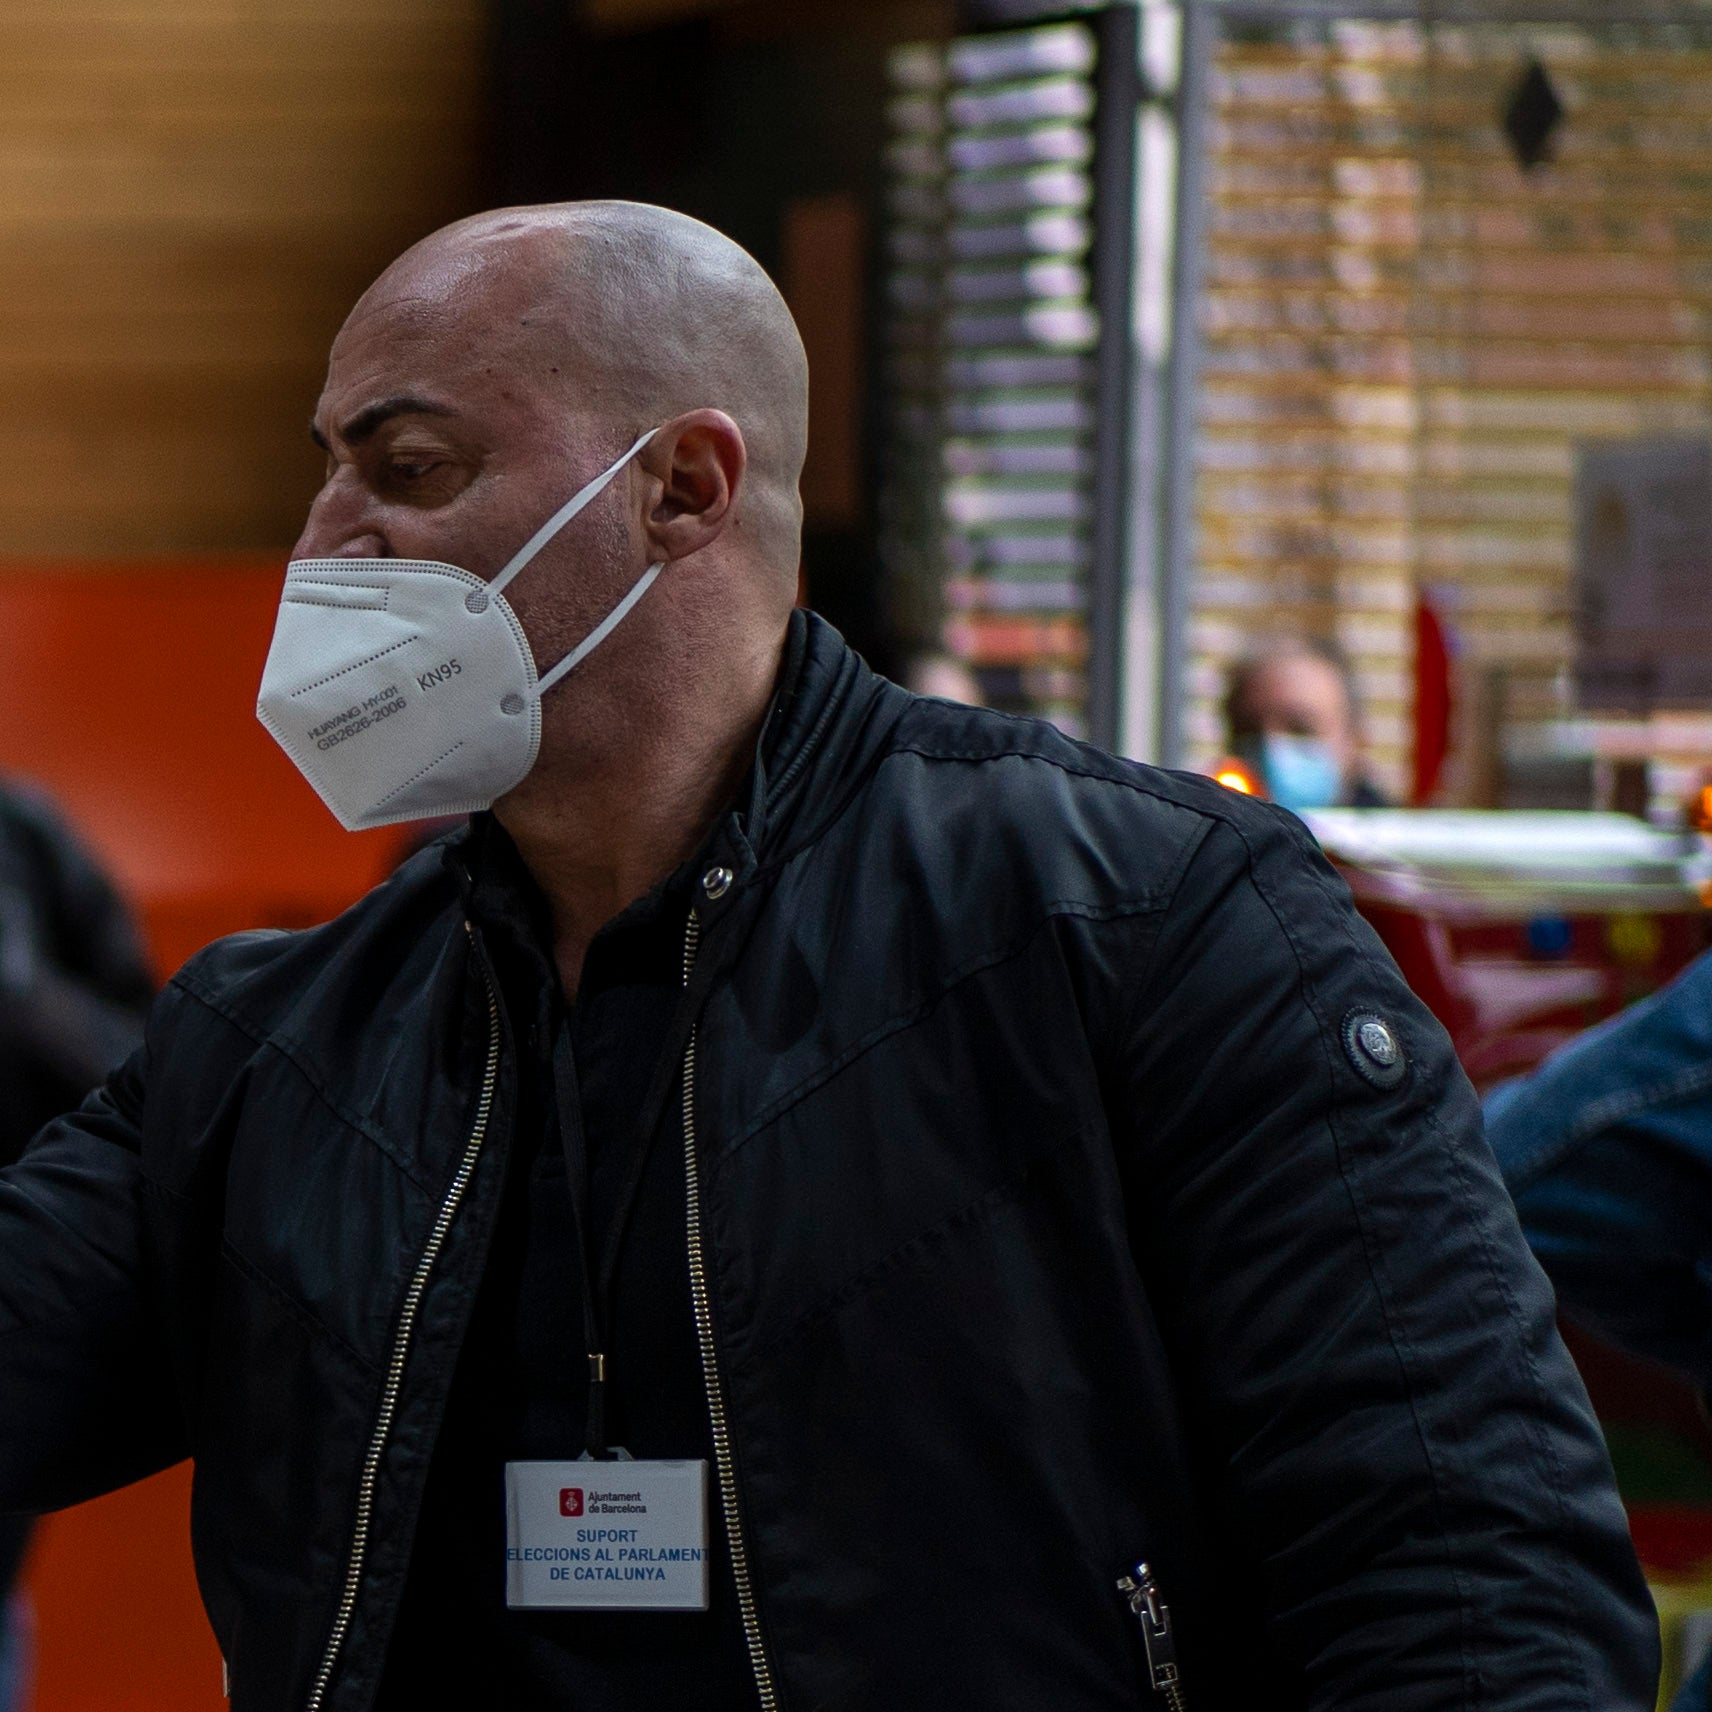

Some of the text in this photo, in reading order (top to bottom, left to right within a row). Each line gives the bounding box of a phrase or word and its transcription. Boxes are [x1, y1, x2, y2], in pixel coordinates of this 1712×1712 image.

[416, 659, 462, 691] KN95
[307, 686, 399, 739] HUAYANG HY-001
[317, 697, 407, 751] GB2626-2006
[588, 1492, 642, 1503] Ajuntament
[588, 1504, 647, 1514] de Barcelona
[576, 1529, 639, 1543] SUPORT
[507, 1548, 591, 1561] ELECCIONS
[594, 1548, 614, 1561] AL
[550, 1567, 666, 1581] DE CATALUNYA
